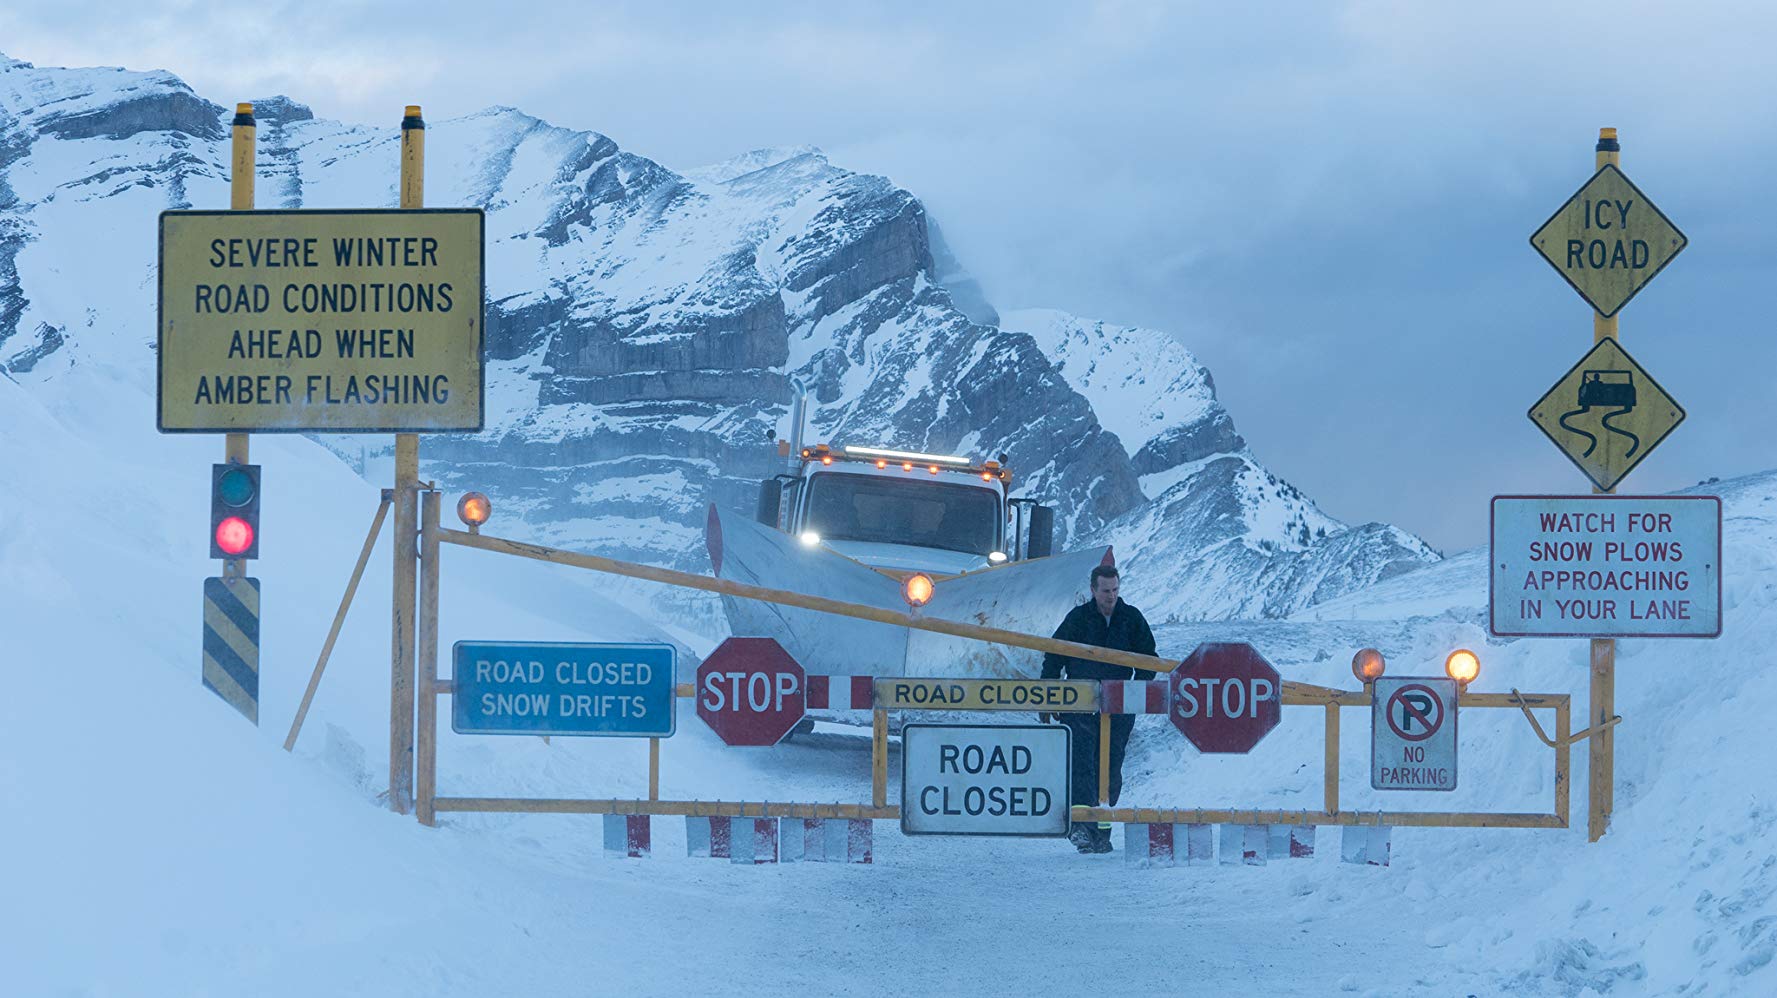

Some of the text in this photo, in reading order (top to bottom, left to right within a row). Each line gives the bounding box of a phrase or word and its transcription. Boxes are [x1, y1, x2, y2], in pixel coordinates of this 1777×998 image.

[1584, 199, 1633, 229] ICY
[209, 237, 438, 267] SEVERE WINTER
[1566, 239, 1650, 269] ROAD
[195, 282, 453, 313] ROAD CONDITIONS
[228, 329, 414, 358] AHEAD WHEN
[194, 374, 449, 403] AMBER FLASHING
[1539, 512, 1673, 532] WATCH FOR
[1529, 541, 1683, 561] SNOW PLOWS
[1523, 570, 1689, 590] APPROACHING
[1520, 599, 1691, 619] IN YOUR LANE
[476, 660, 652, 685] ROAD CLOSED
[481, 692, 647, 718] SNOW DRIFTS
[703, 671, 798, 712] STOP
[895, 682, 1079, 705] ROAD CLOSED
[1178, 677, 1275, 718] STOP
[939, 744, 1033, 774] ROAD
[1404, 746, 1425, 763] NO
[1381, 767, 1448, 784] PARKING
[919, 786, 1052, 816] CLOSED
